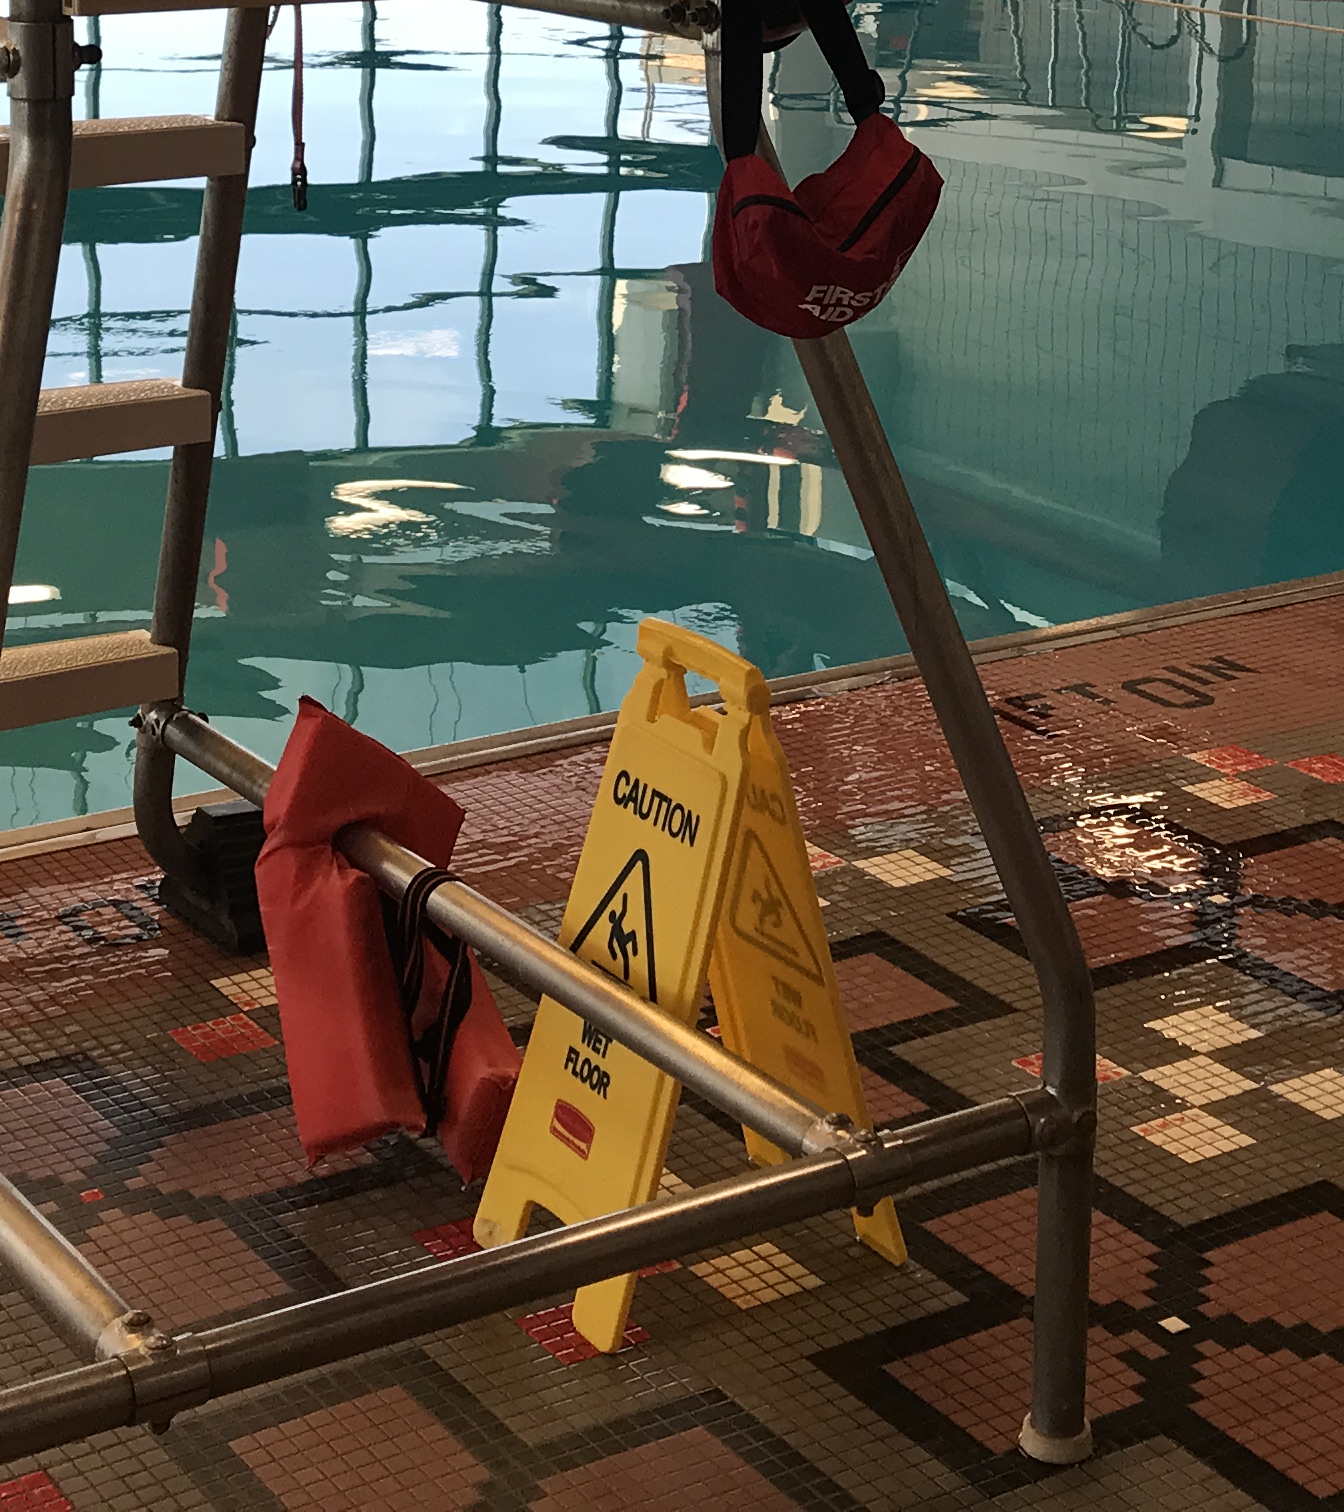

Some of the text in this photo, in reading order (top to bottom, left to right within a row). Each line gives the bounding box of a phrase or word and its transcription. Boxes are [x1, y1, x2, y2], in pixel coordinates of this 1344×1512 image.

[797, 304, 854, 322] AID
[612, 769, 700, 848] CAUTION
[581, 1019, 613, 1059] WET
[563, 1045, 611, 1100] FLOOR
